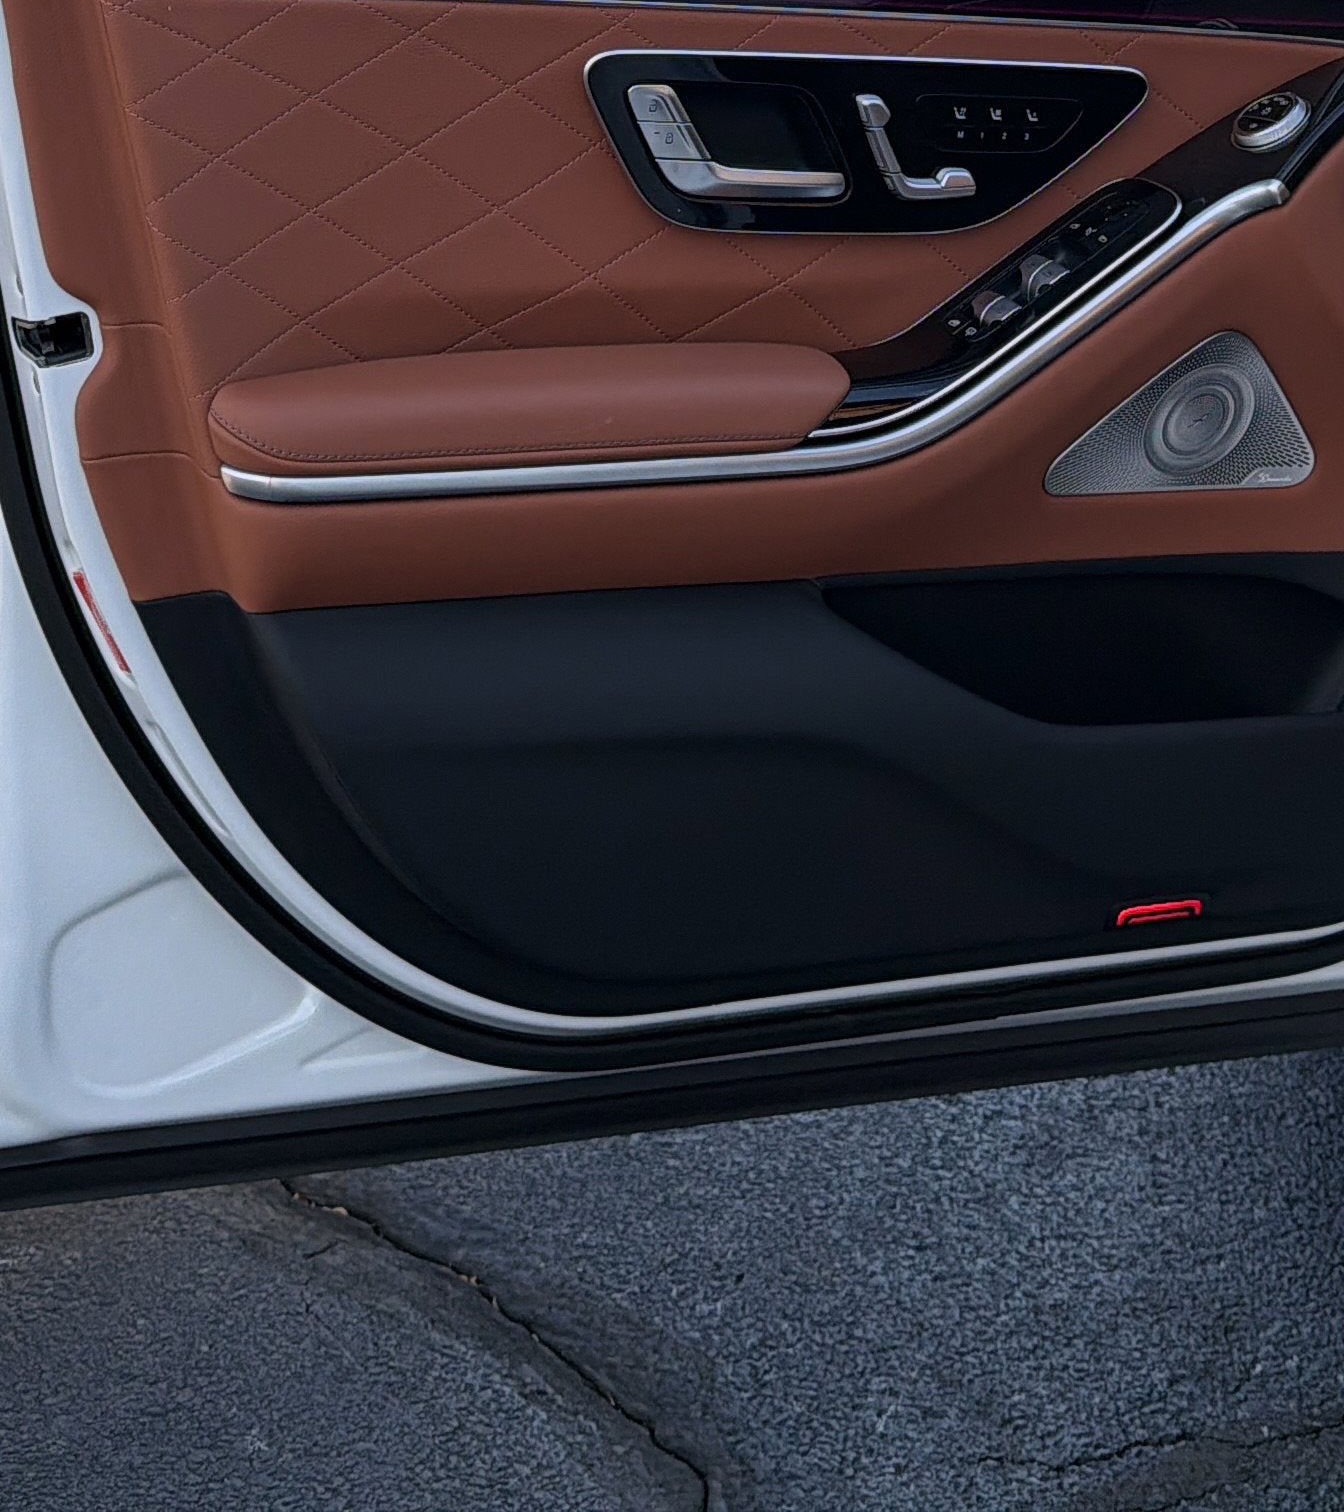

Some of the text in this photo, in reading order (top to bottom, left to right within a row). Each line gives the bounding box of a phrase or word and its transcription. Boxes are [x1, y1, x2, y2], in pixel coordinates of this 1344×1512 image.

[957, 130, 965, 139] M
[1001, 131, 1008, 140] 2
[1023, 132, 1030, 141] 3
